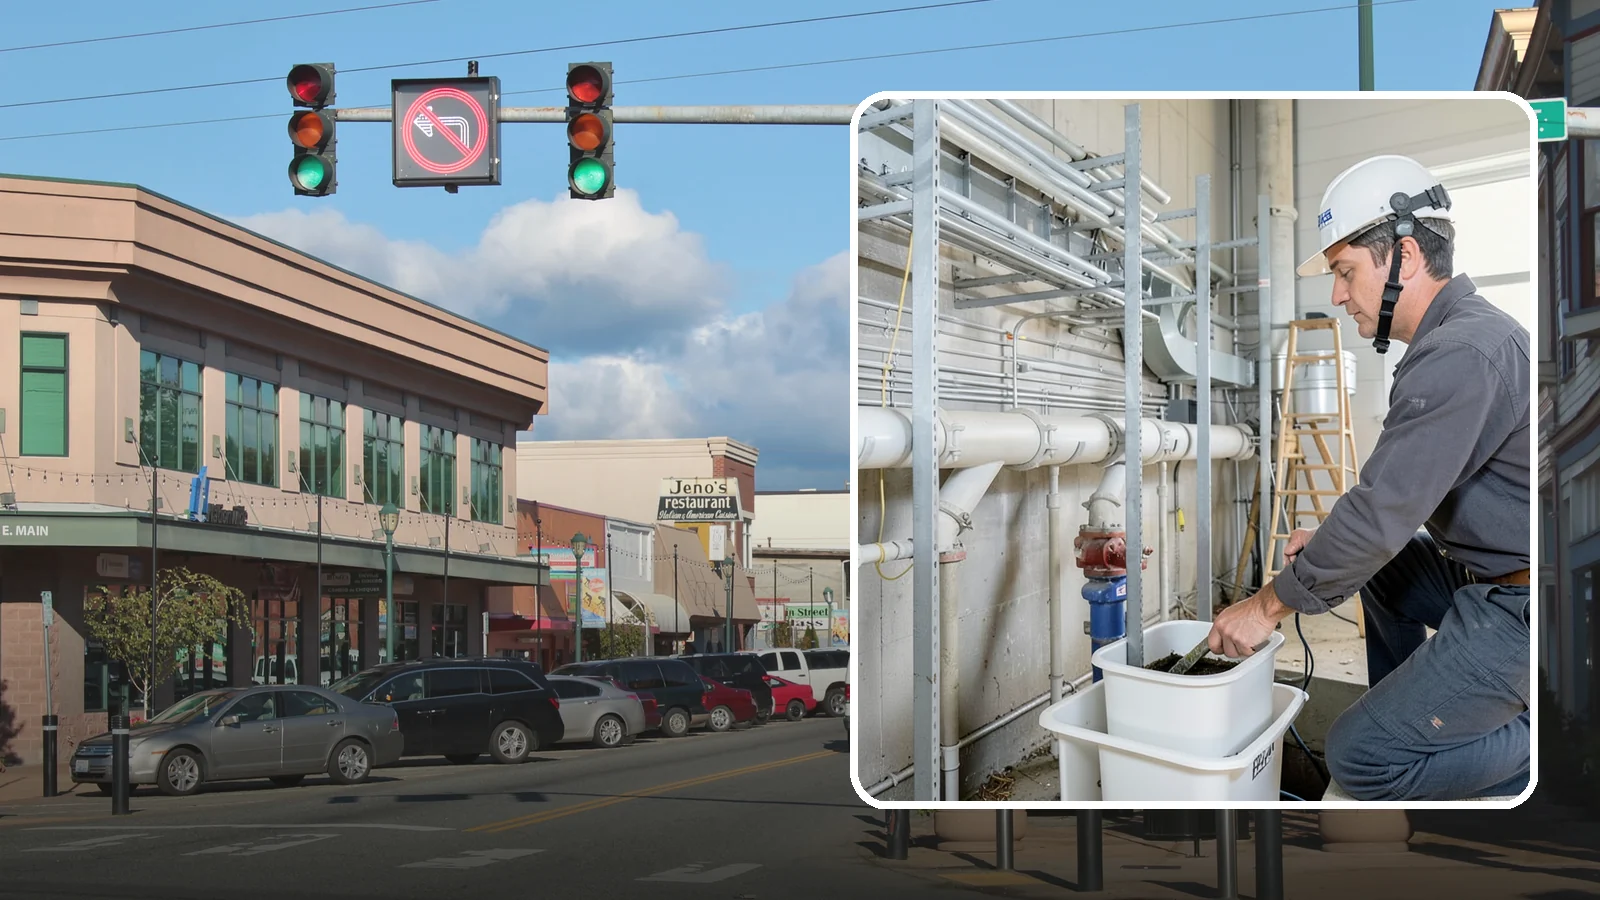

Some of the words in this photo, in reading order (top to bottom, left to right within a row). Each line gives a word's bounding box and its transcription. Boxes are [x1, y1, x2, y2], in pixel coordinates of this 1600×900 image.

[670, 480, 727, 494] Jeno's
[665, 496, 731, 509] restaurant
[686, 510, 715, 520] American
[715, 509, 737, 519] Cuisine
[2, 525, 13, 536] E.
[15, 525, 49, 536] MAIN
[797, 607, 828, 617] Street
